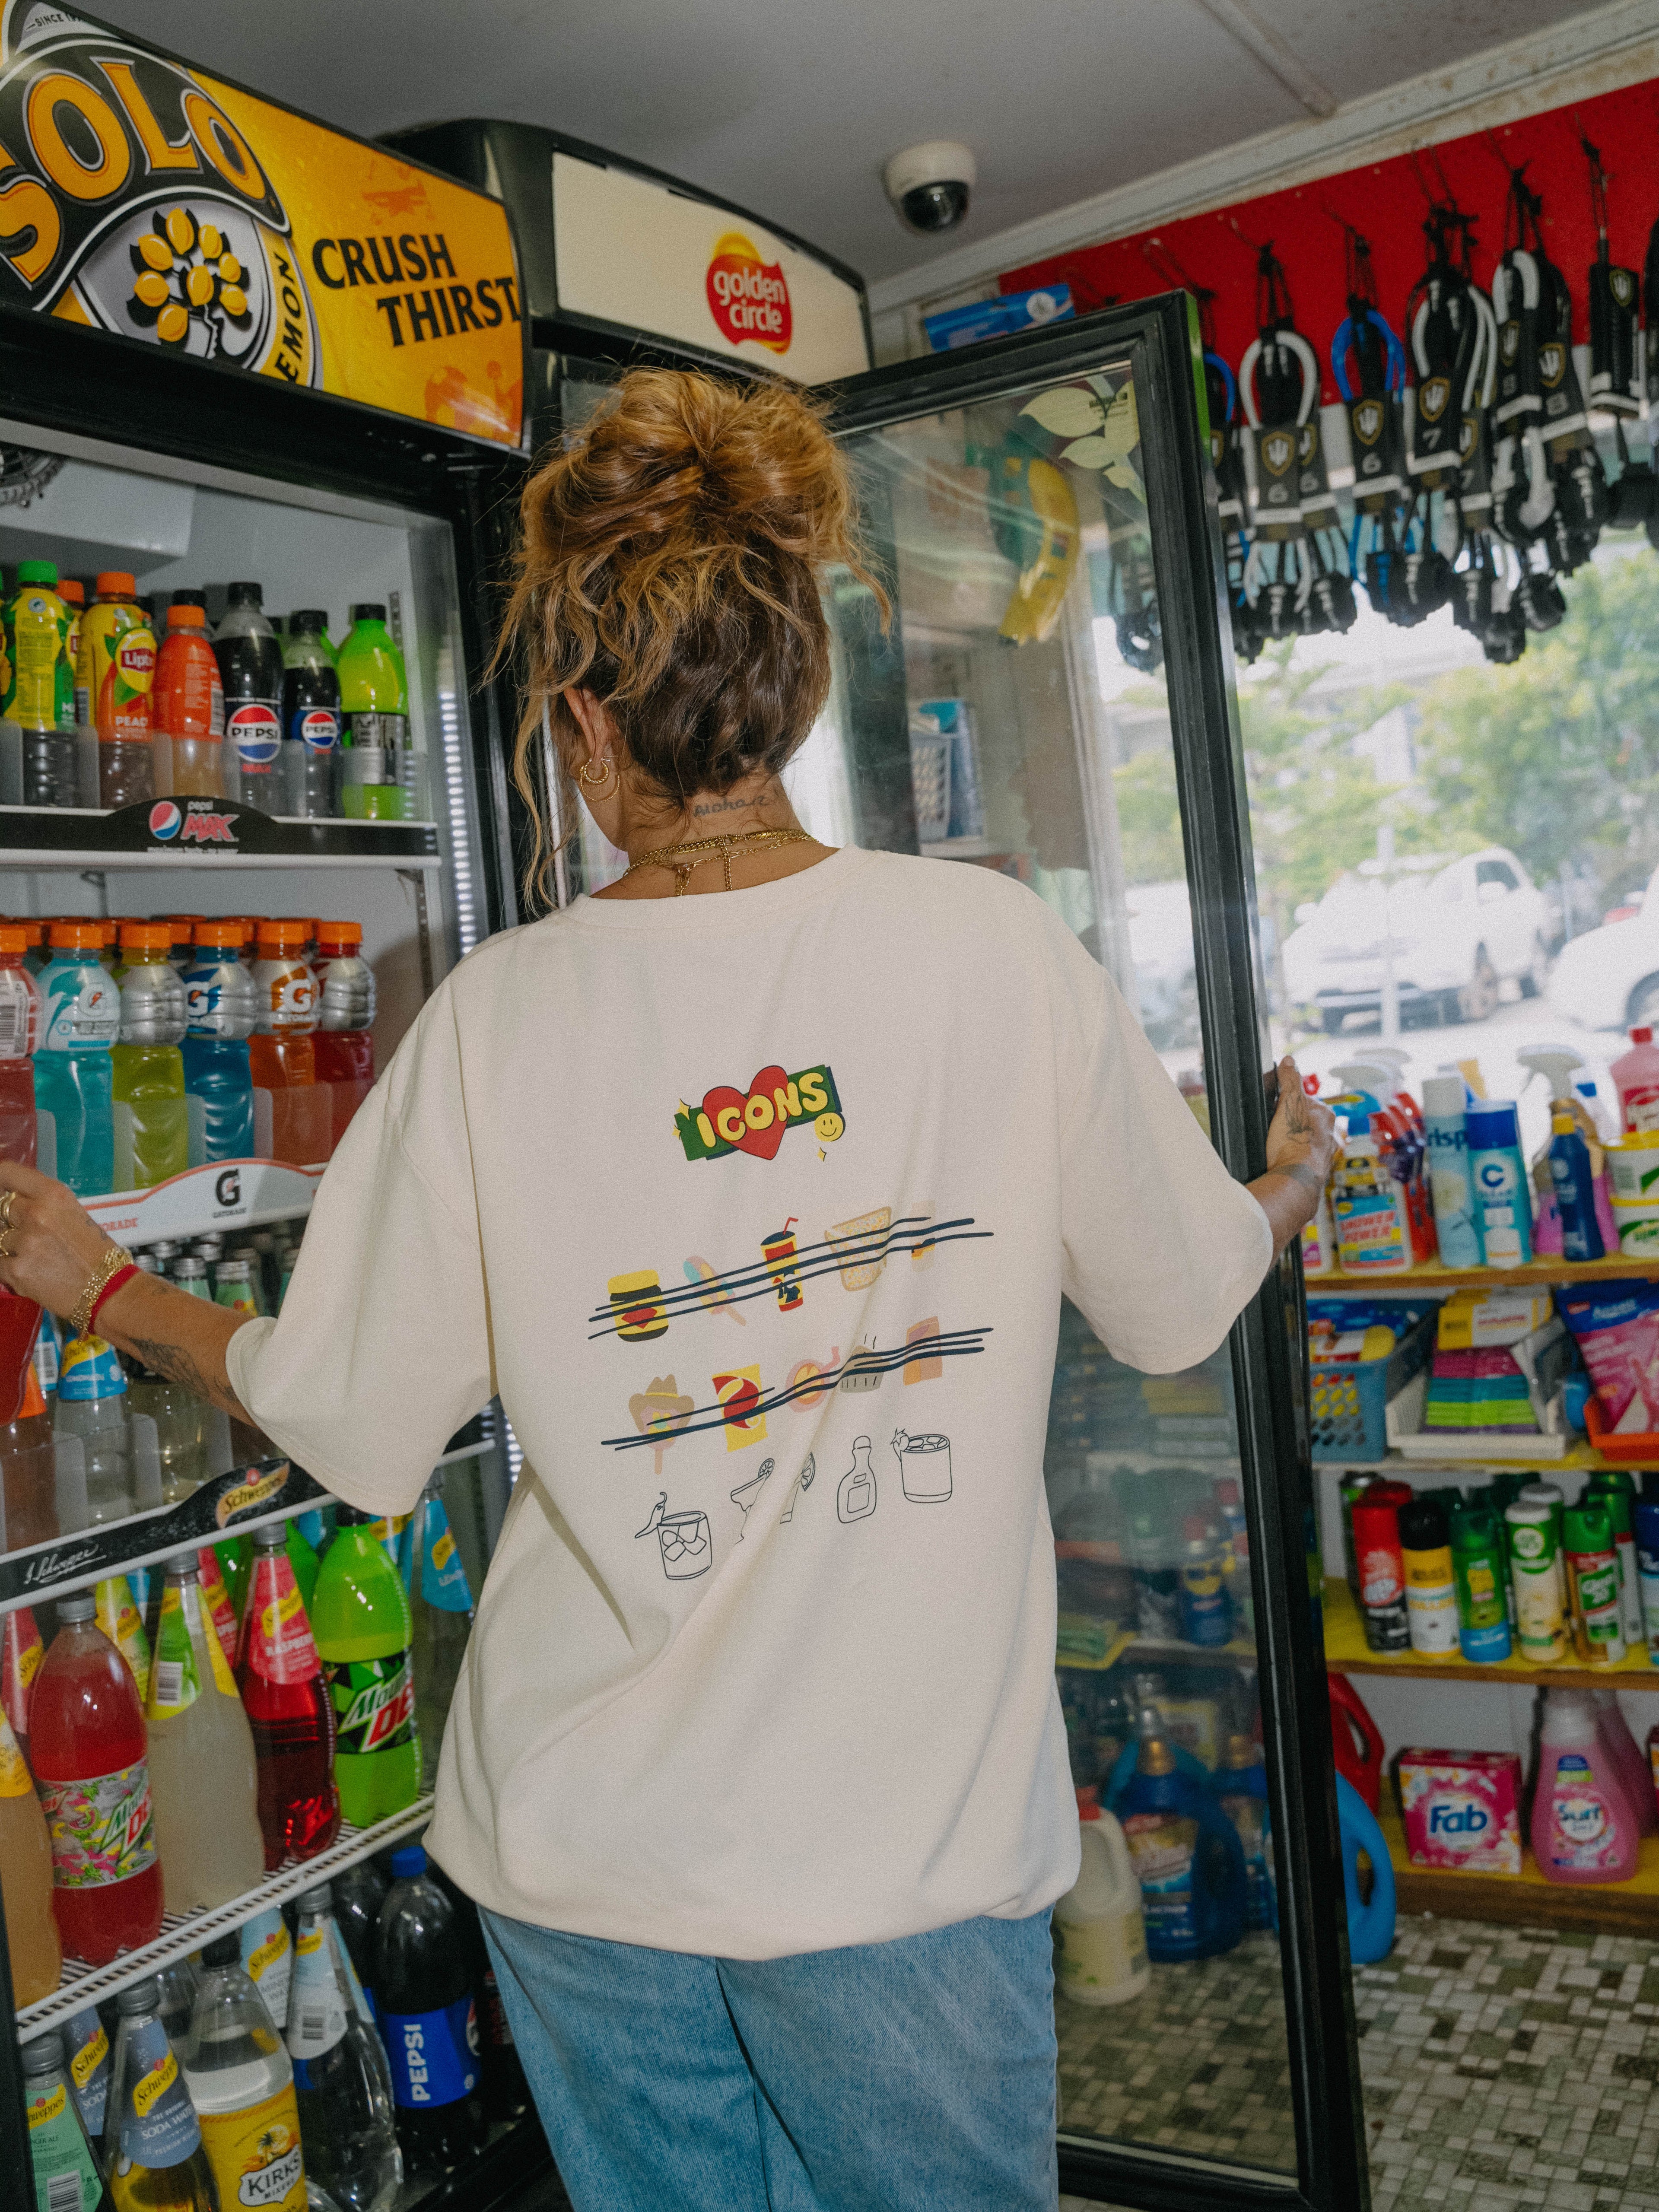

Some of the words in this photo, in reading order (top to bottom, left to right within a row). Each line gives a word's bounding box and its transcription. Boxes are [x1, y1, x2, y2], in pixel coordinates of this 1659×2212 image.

[35, 14, 64, 27] SINCE
[312, 234, 457, 289] CRUSH
[713, 267, 785, 306] golden
[377, 277, 522, 348] THIRST
[729, 298, 783, 334] circle
[1422, 427, 1442, 449] 7
[1361, 452, 1381, 474] 6
[1267, 483, 1289, 503] 6
[188, 801, 213, 812] pepsi
[180, 812, 240, 842] MAX
[281, 979, 312, 1013] G
[696, 1072, 828, 1147] ICONS
[215, 1169, 240, 1207] G
[1481, 1164, 1505, 1187] C
[99, 1218, 138, 1233] ORADE
[1430, 1805, 1487, 1834] Fab
[403, 2024, 431, 2101] PEPSI
[141, 2121, 172, 2139] SODA
